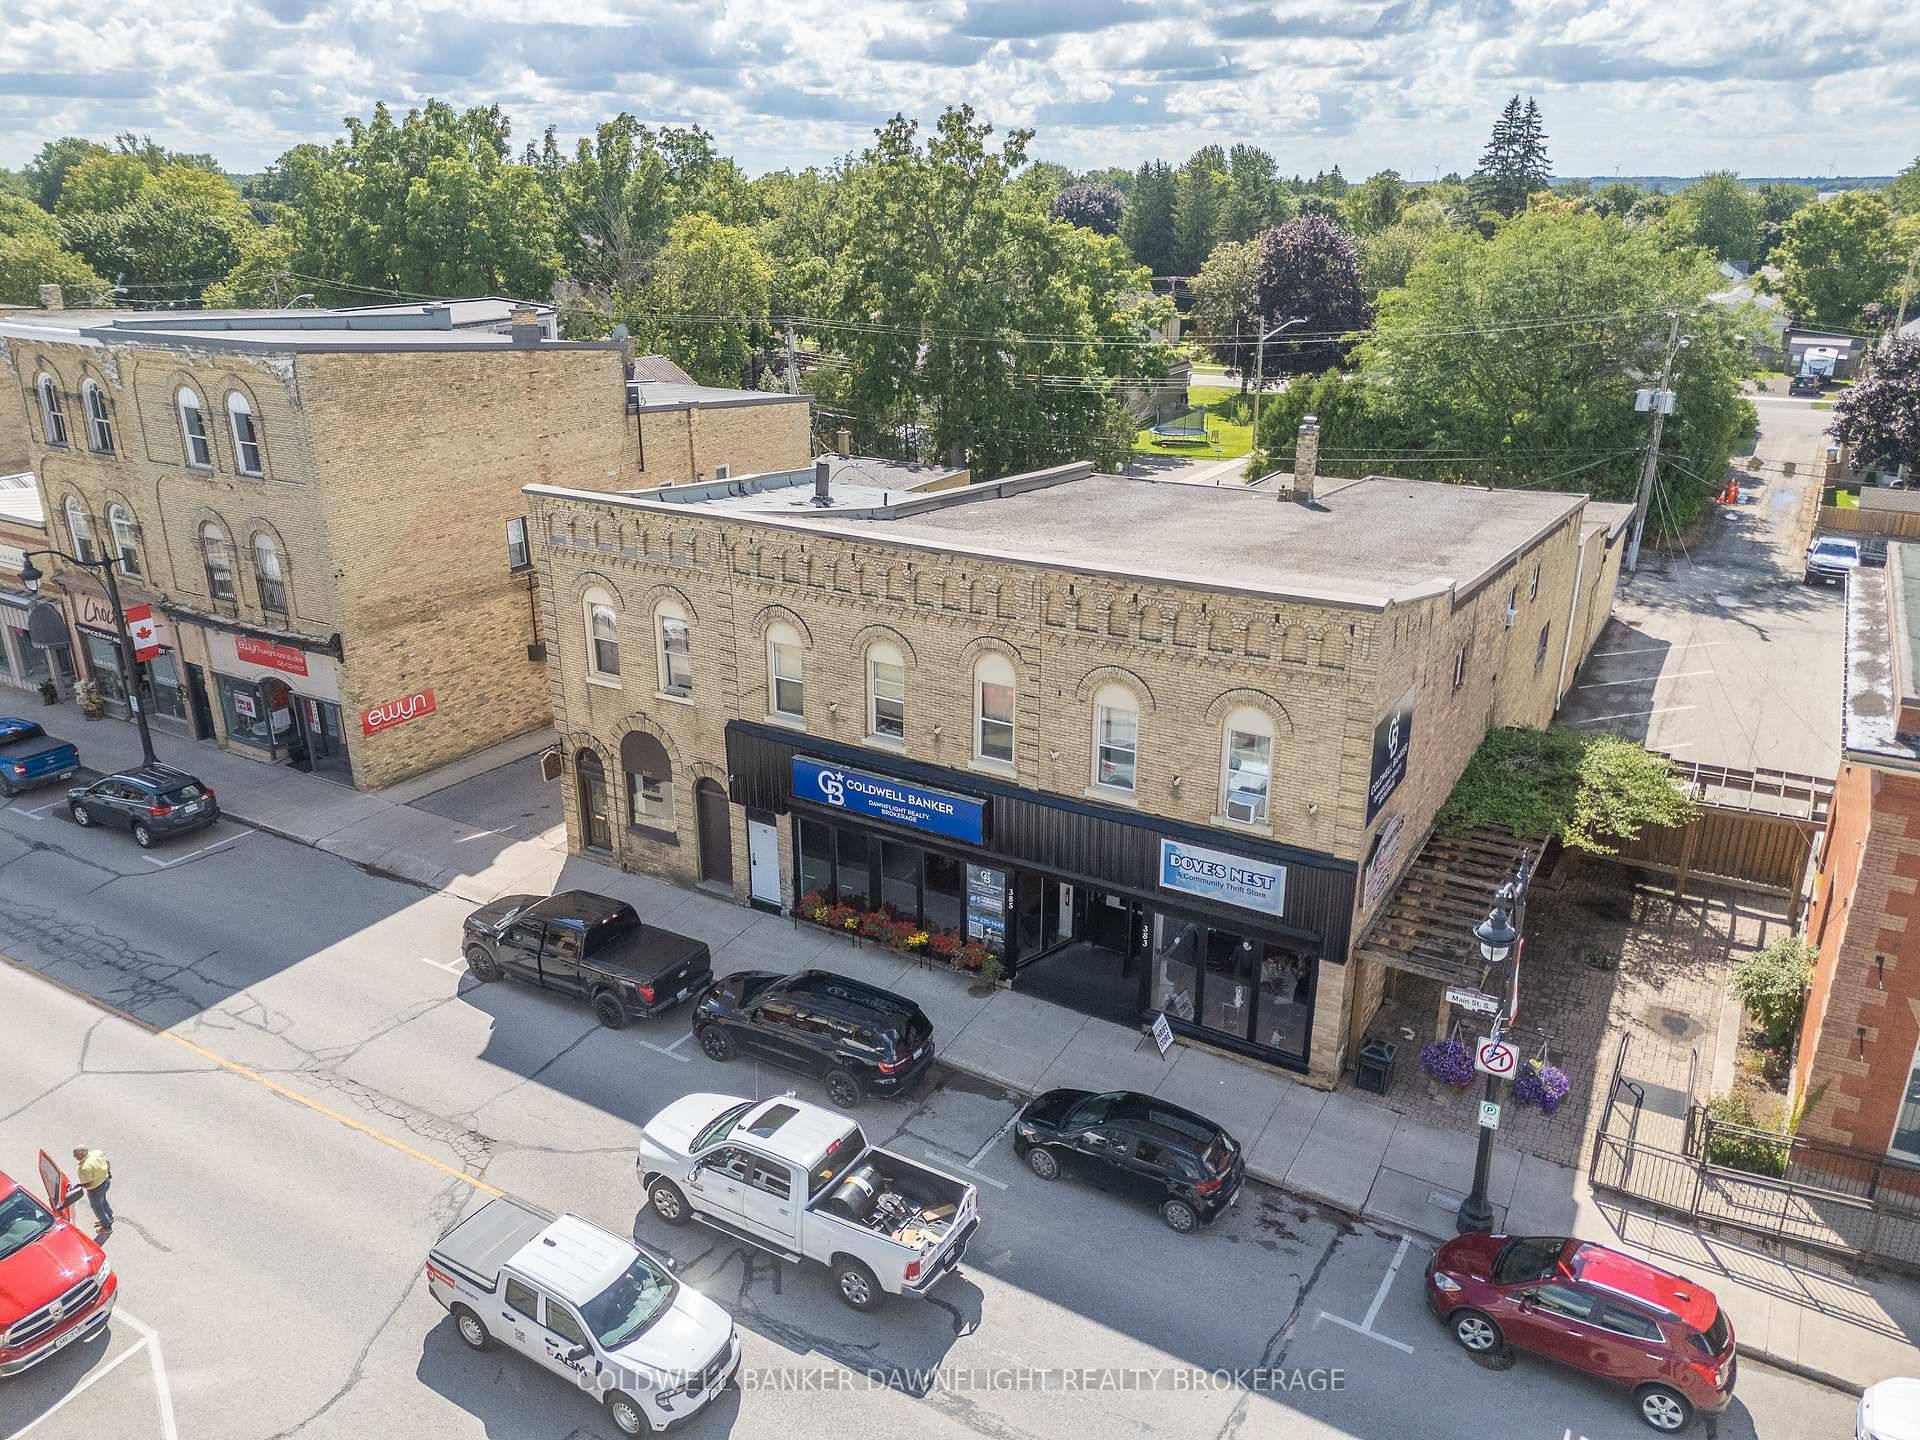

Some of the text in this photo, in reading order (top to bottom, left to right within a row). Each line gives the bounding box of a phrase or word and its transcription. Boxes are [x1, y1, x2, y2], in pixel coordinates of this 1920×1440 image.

[368, 694, 427, 726] ewyn
[846, 780, 954, 816] COLDWELL BANKER
[868, 800, 907, 814] DAWNFLIGHT
[881, 808, 918, 823] BROKERAGE
[1169, 852, 1276, 890] DOVE'S NEST
[1181, 871, 1225, 890] Community
[1226, 882, 1245, 894] Thrift
[1246, 888, 1267, 899] Store
[1451, 994, 1470, 1005] Main
[1471, 999, 1482, 1008] St.
[554, 1352, 588, 1377] AGM
